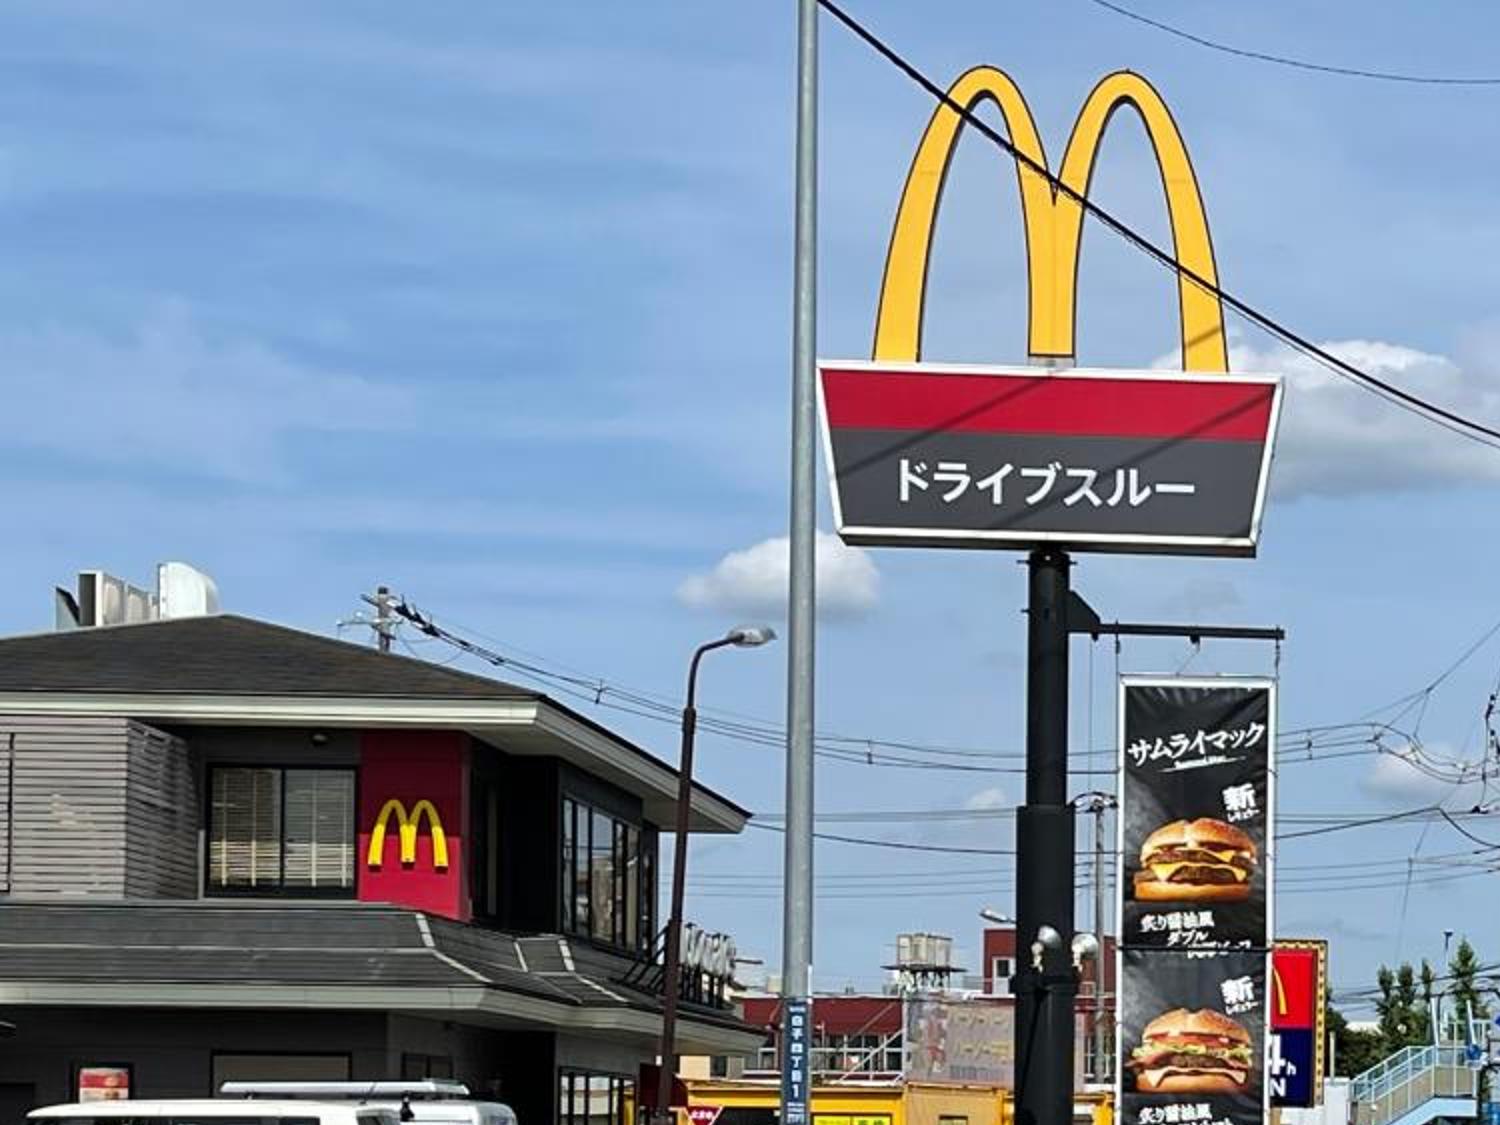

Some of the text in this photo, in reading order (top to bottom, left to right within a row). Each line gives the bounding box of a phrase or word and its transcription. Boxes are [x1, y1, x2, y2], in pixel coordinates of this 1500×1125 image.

[899, 459, 1196, 507] ドライブスルー
[1127, 722, 1265, 766] サムライマック
[1167, 930, 1209, 947] ダブル
